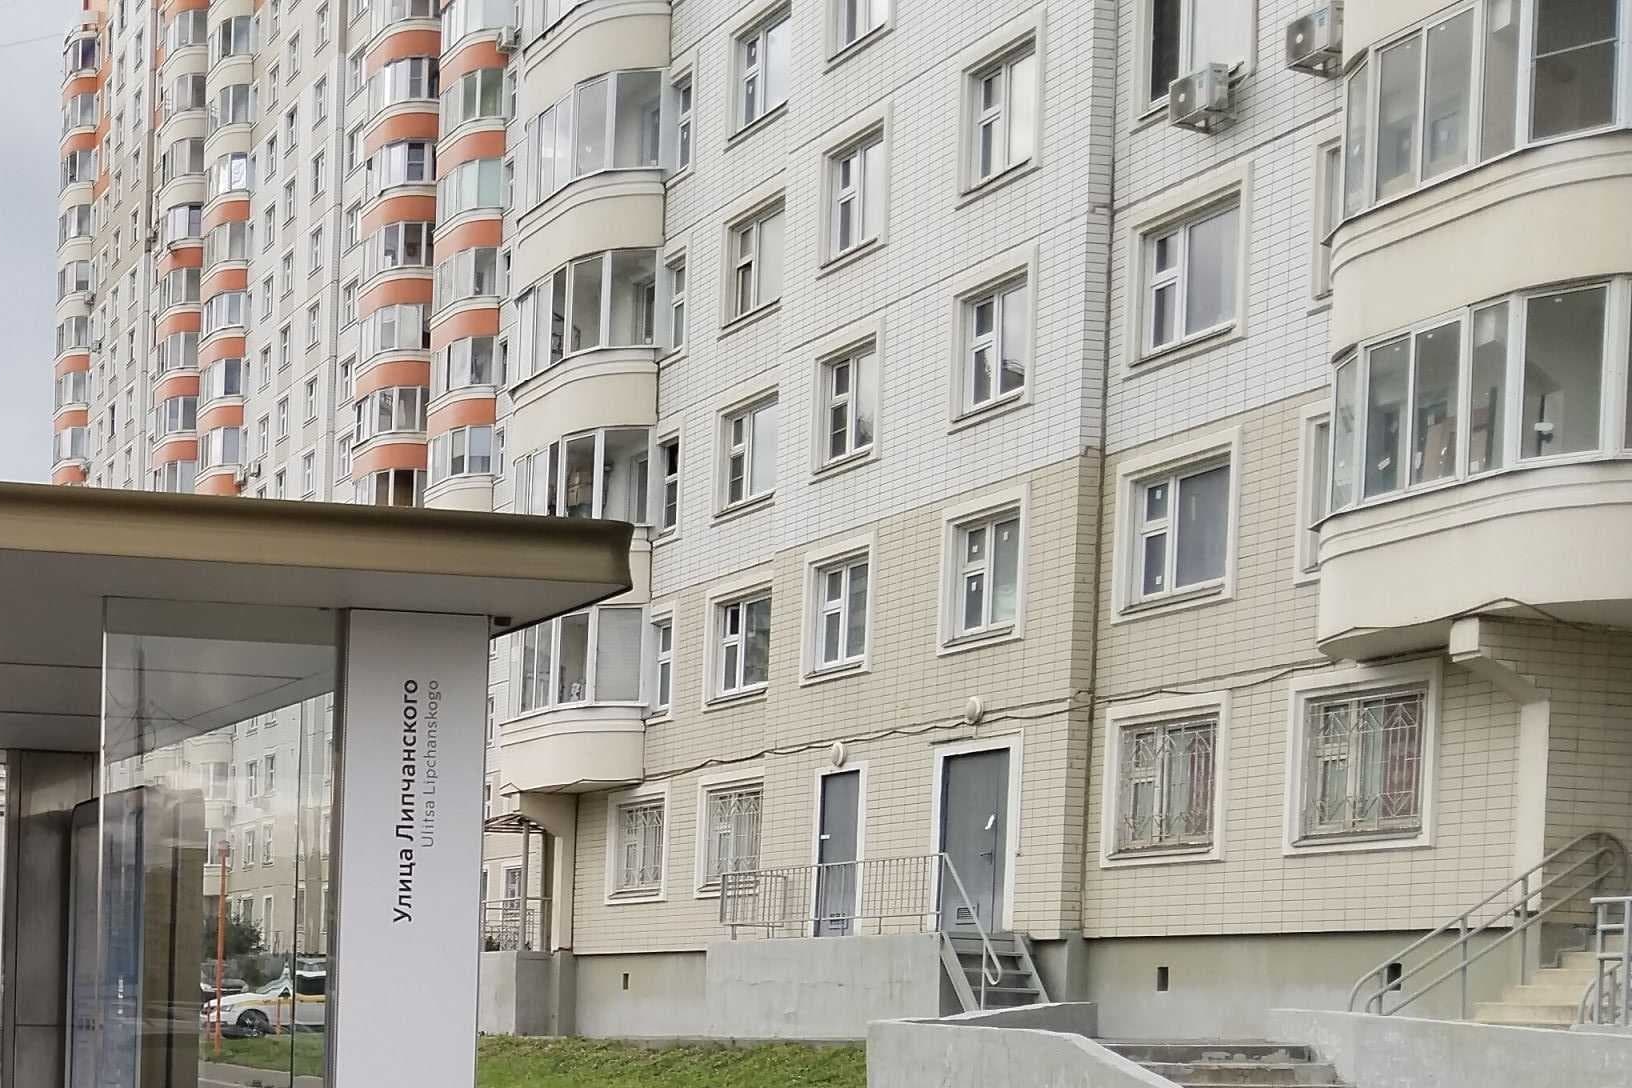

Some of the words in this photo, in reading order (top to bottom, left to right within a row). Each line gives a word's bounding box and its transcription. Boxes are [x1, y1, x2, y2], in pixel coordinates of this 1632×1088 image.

[395, 679, 419, 842] Липчанского
[422, 680, 442, 795] Lipchanskogo
[421, 800, 436, 848] Ulitsa
[393, 848, 416, 923] Улица
